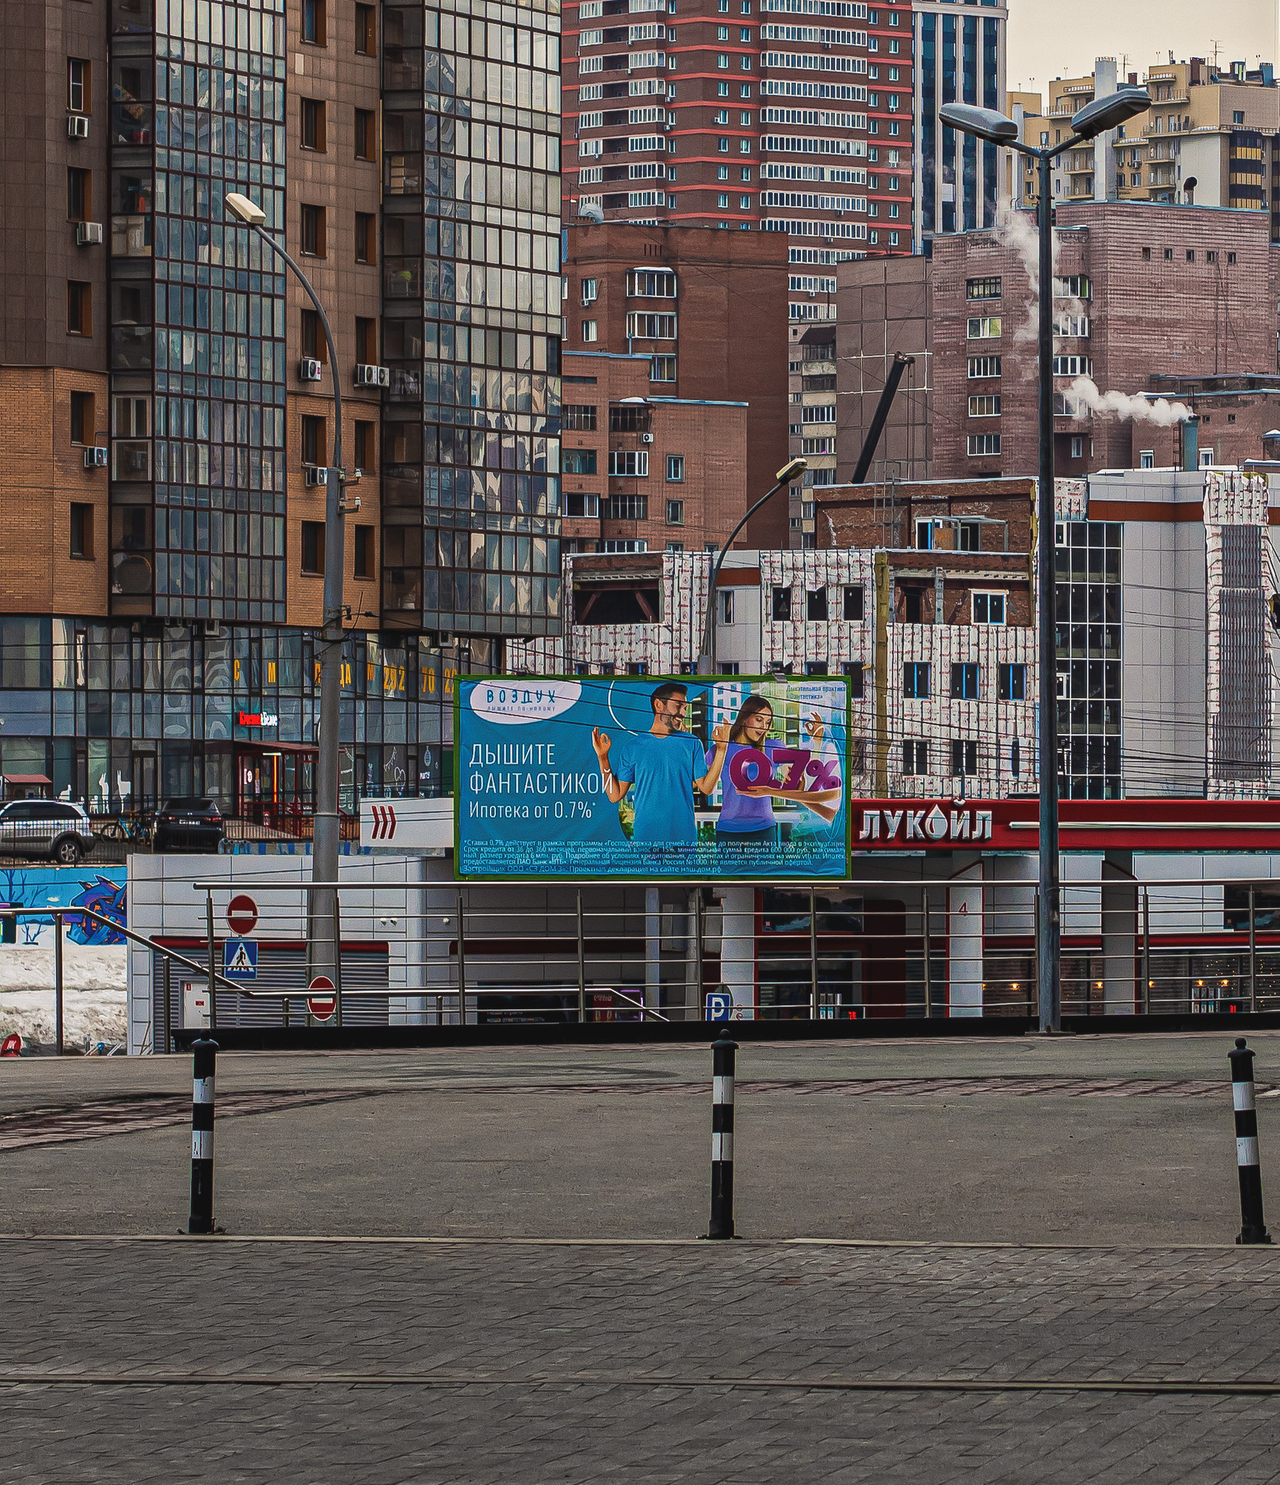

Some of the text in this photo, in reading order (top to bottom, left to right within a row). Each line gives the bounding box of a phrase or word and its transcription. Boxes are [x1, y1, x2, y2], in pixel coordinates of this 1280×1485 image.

[487, 689, 556, 703] ВОЗДУХ
[469, 743, 555, 768] ДЫШИТЕ
[469, 769, 614, 795] ФАНТАСТИКОЙ
[469, 801, 529, 818] Ипотека
[534, 805, 549, 818] от
[859, 803, 993, 840] ЛУКОЙЛ
[958, 902, 969, 916] 4
